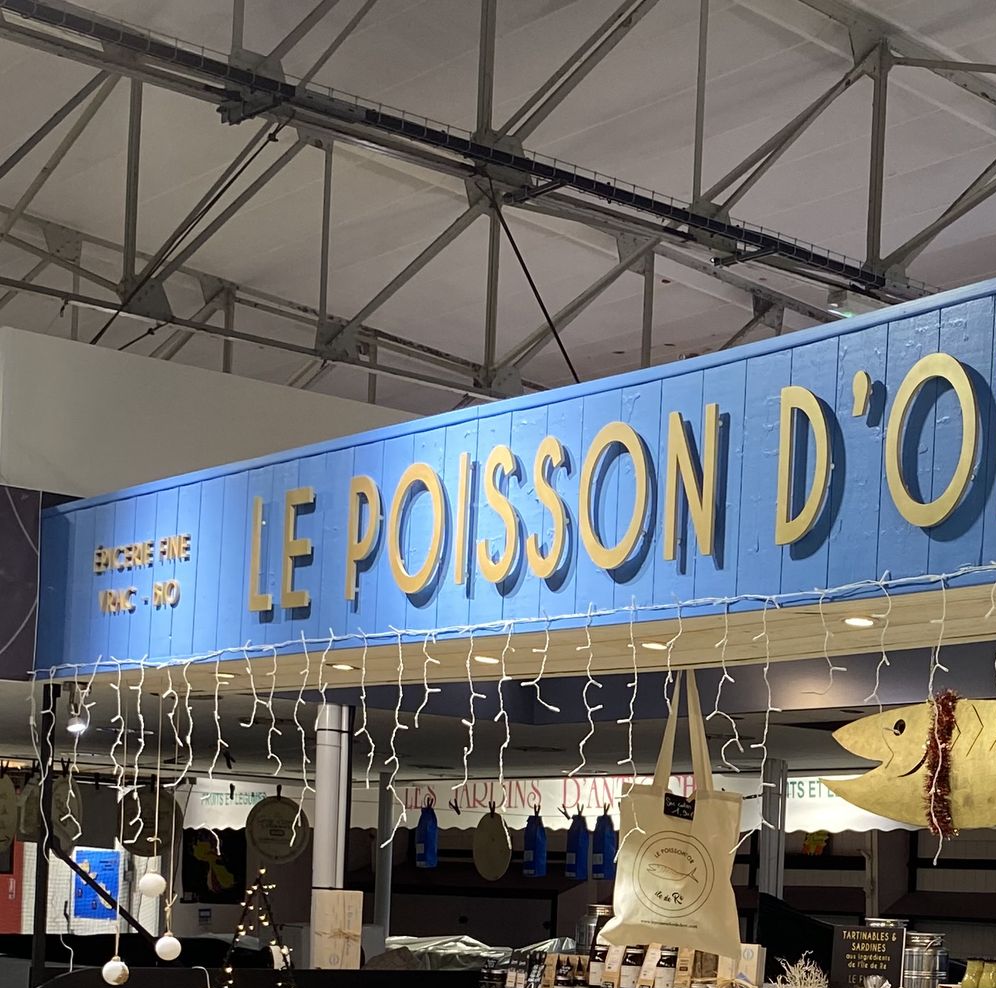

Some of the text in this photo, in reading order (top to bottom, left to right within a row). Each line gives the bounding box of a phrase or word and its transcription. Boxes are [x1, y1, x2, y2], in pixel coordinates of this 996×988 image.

[249, 486, 314, 612] LE
[345, 403, 719, 602] POISSON
[159, 533, 190, 561] FINE
[404, 785, 436, 810] LES
[843, 930, 897, 942] TARTINABLES &
[851, 942, 886, 952] SARDINES
